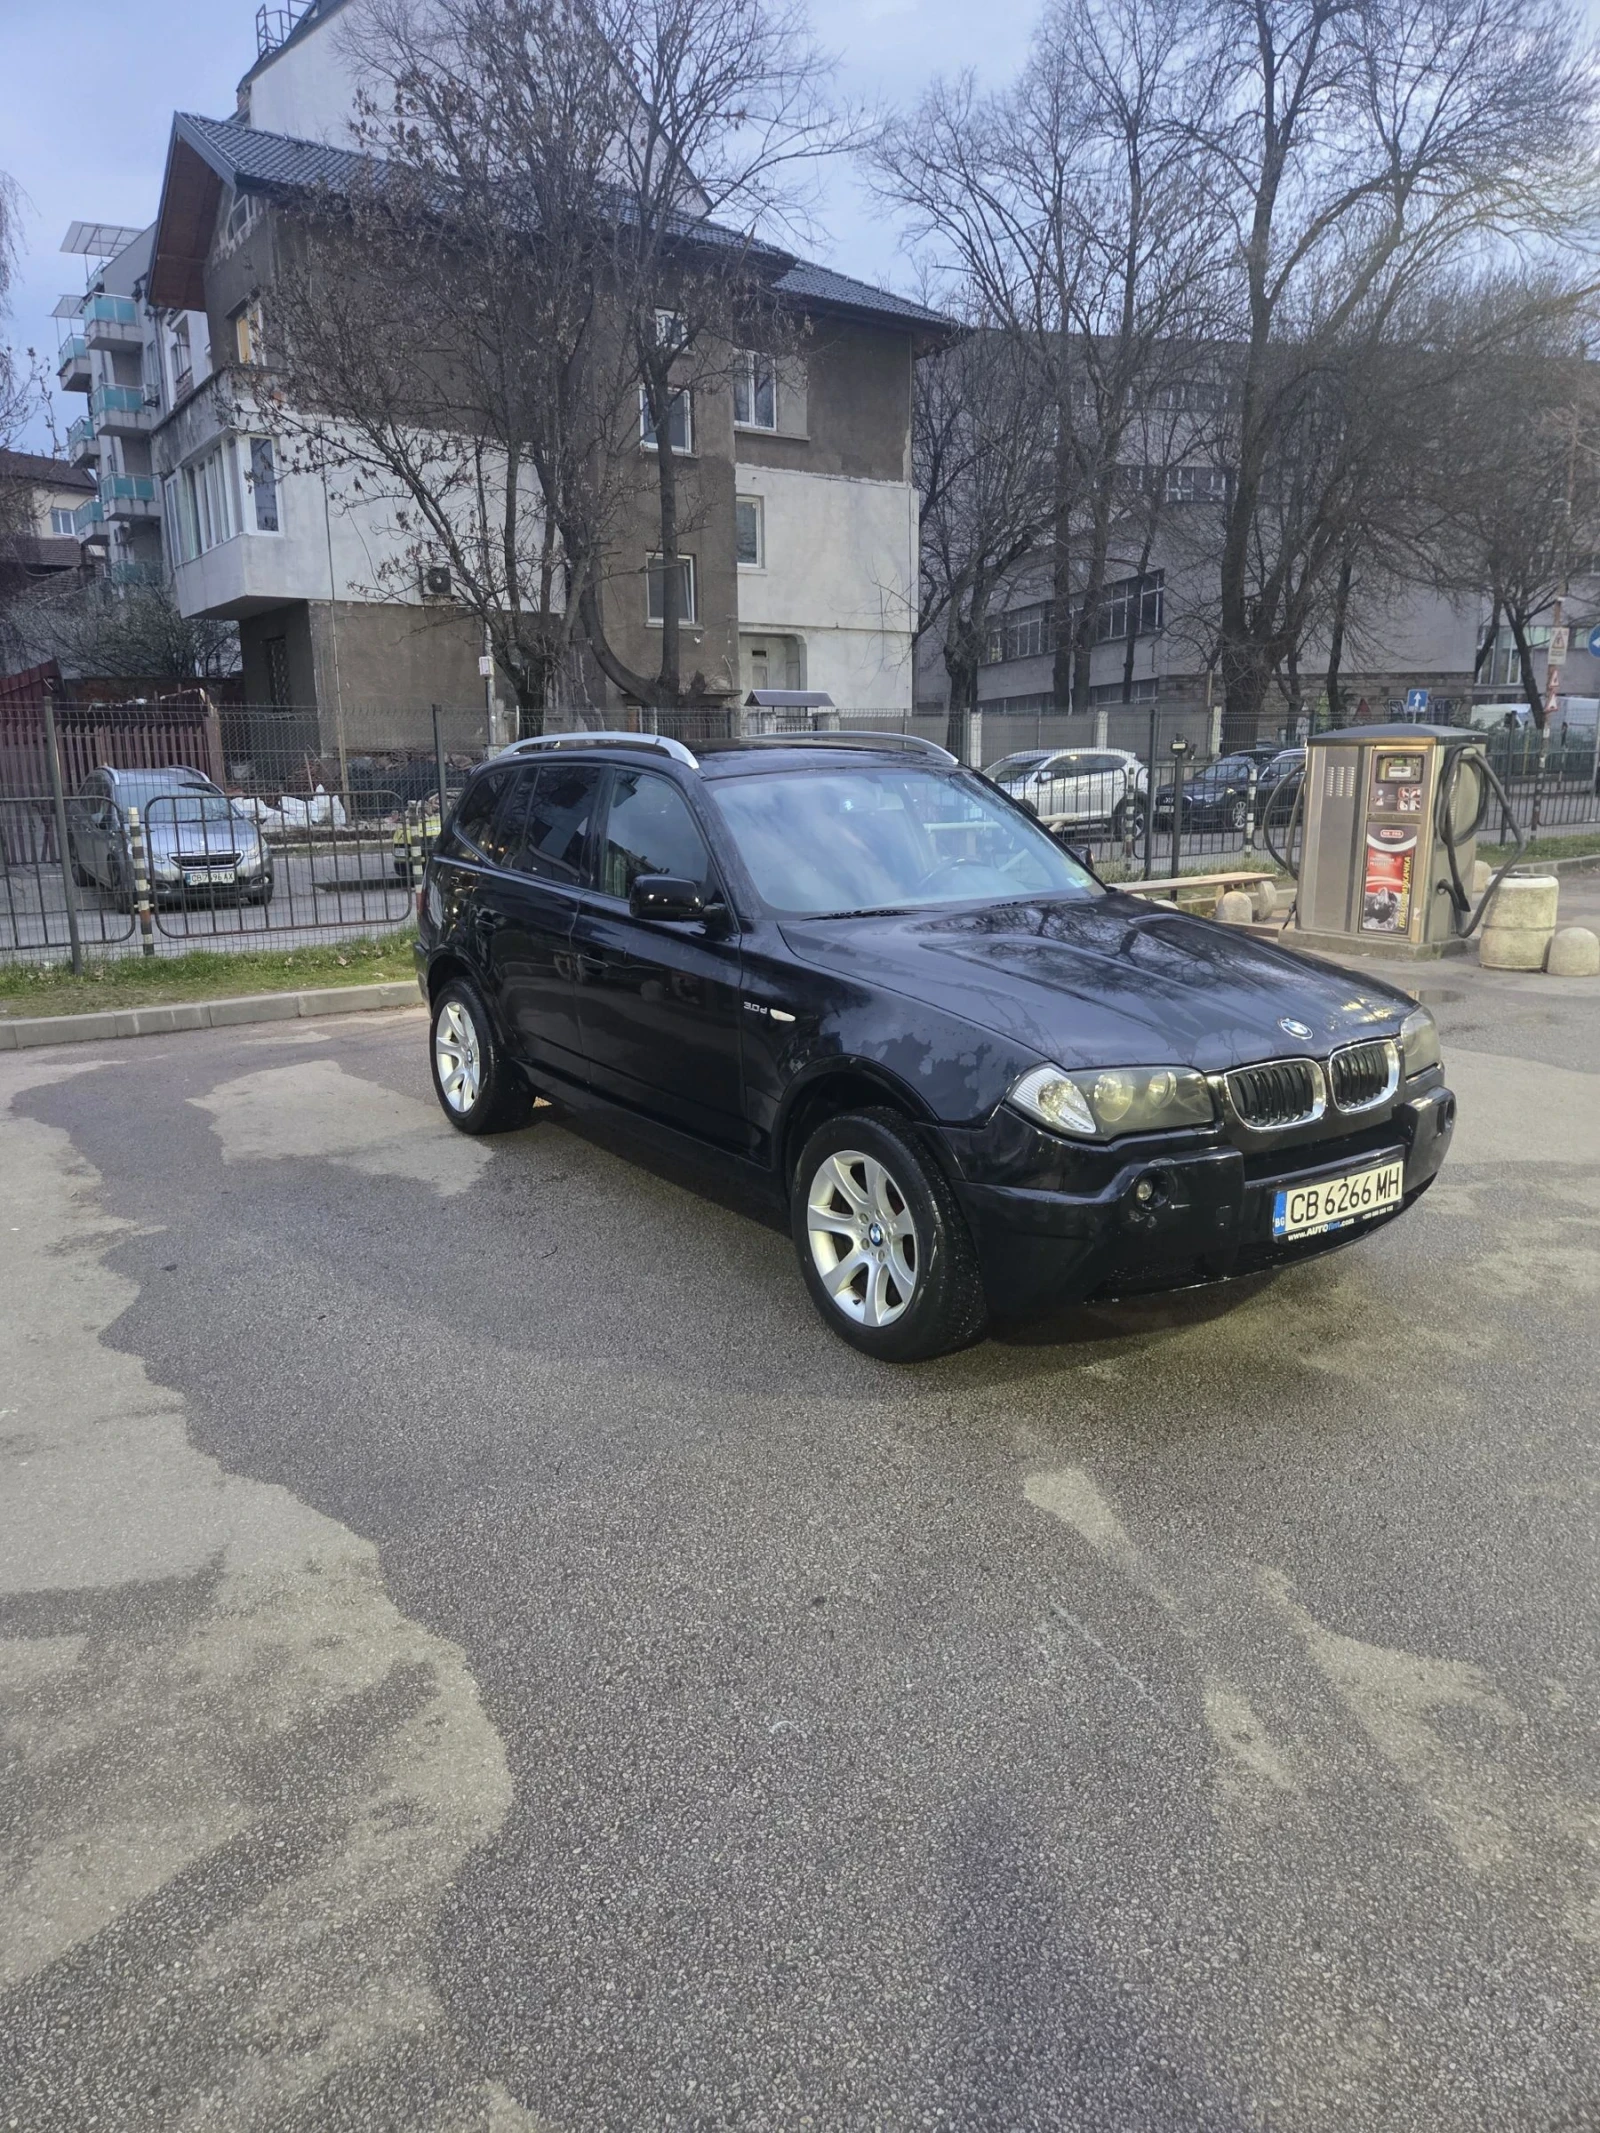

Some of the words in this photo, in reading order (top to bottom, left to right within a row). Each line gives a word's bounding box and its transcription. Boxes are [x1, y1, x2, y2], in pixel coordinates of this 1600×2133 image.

[192, 874, 202, 882] CB
[202, 873, 222, 882] 796
[223, 872, 233, 880] AX
[1290, 1190, 1319, 1224] CB
[1324, 1175, 1371, 1215] 6266
[1375, 1166, 1400, 1202] MH
[1275, 1217, 1285, 1228] BG
